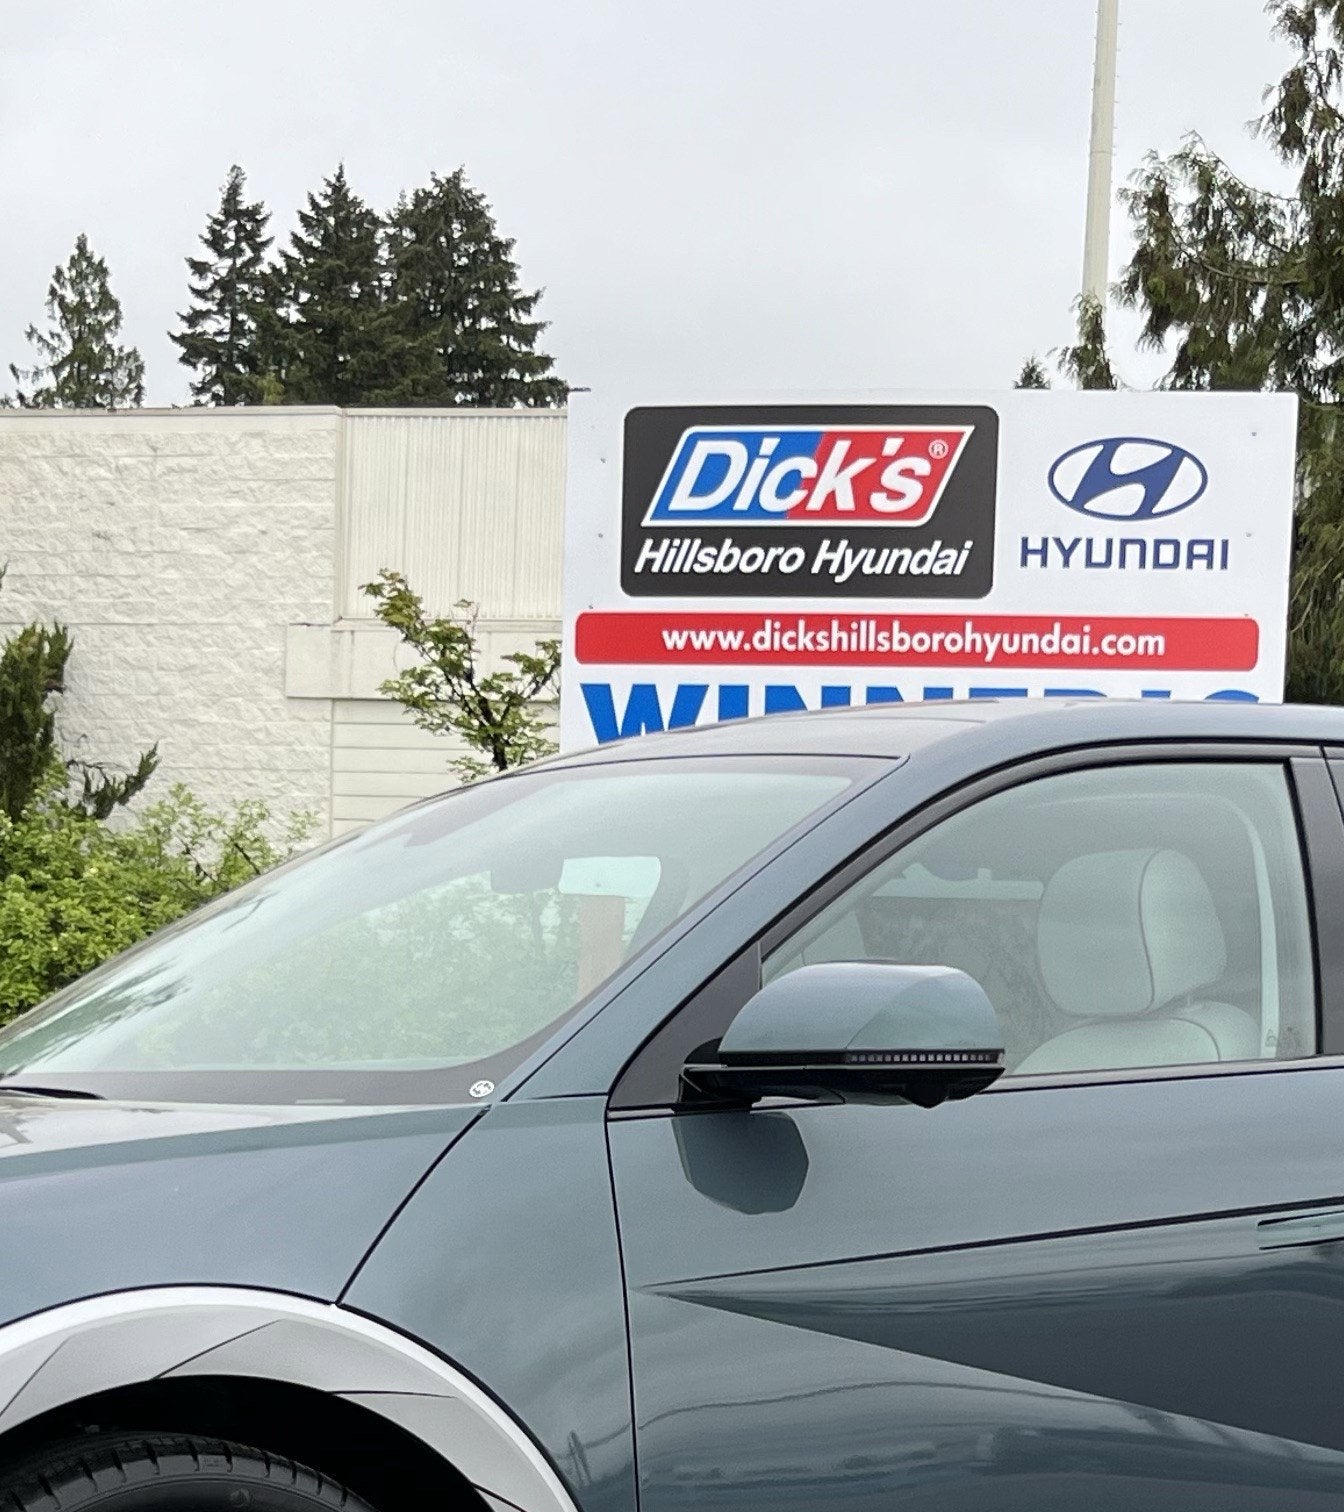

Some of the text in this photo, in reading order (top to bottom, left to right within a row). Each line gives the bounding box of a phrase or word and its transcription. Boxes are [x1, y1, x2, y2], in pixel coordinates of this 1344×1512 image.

[634, 537, 973, 584] Hillsboro Hyundai
[1020, 538, 1229, 571] HYUNDAI
[662, 619, 1166, 662] www.dickshillsborohyundai.com
